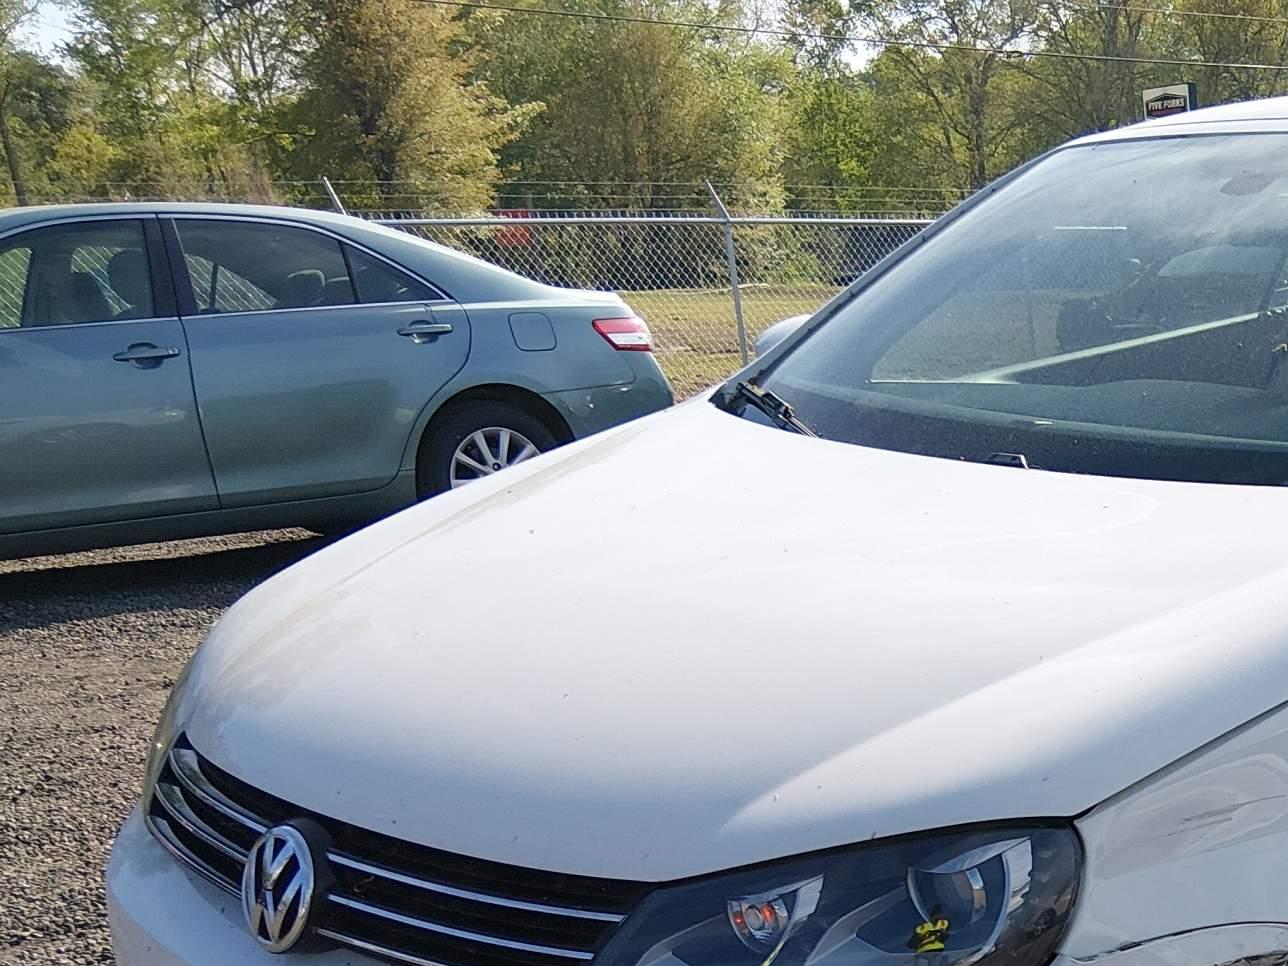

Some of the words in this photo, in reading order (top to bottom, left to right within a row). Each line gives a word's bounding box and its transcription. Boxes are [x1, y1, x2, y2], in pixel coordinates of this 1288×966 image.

[1148, 101, 1162, 111] FIVE
[1163, 99, 1185, 109] FORKS
[244, 827, 313, 951] VW
